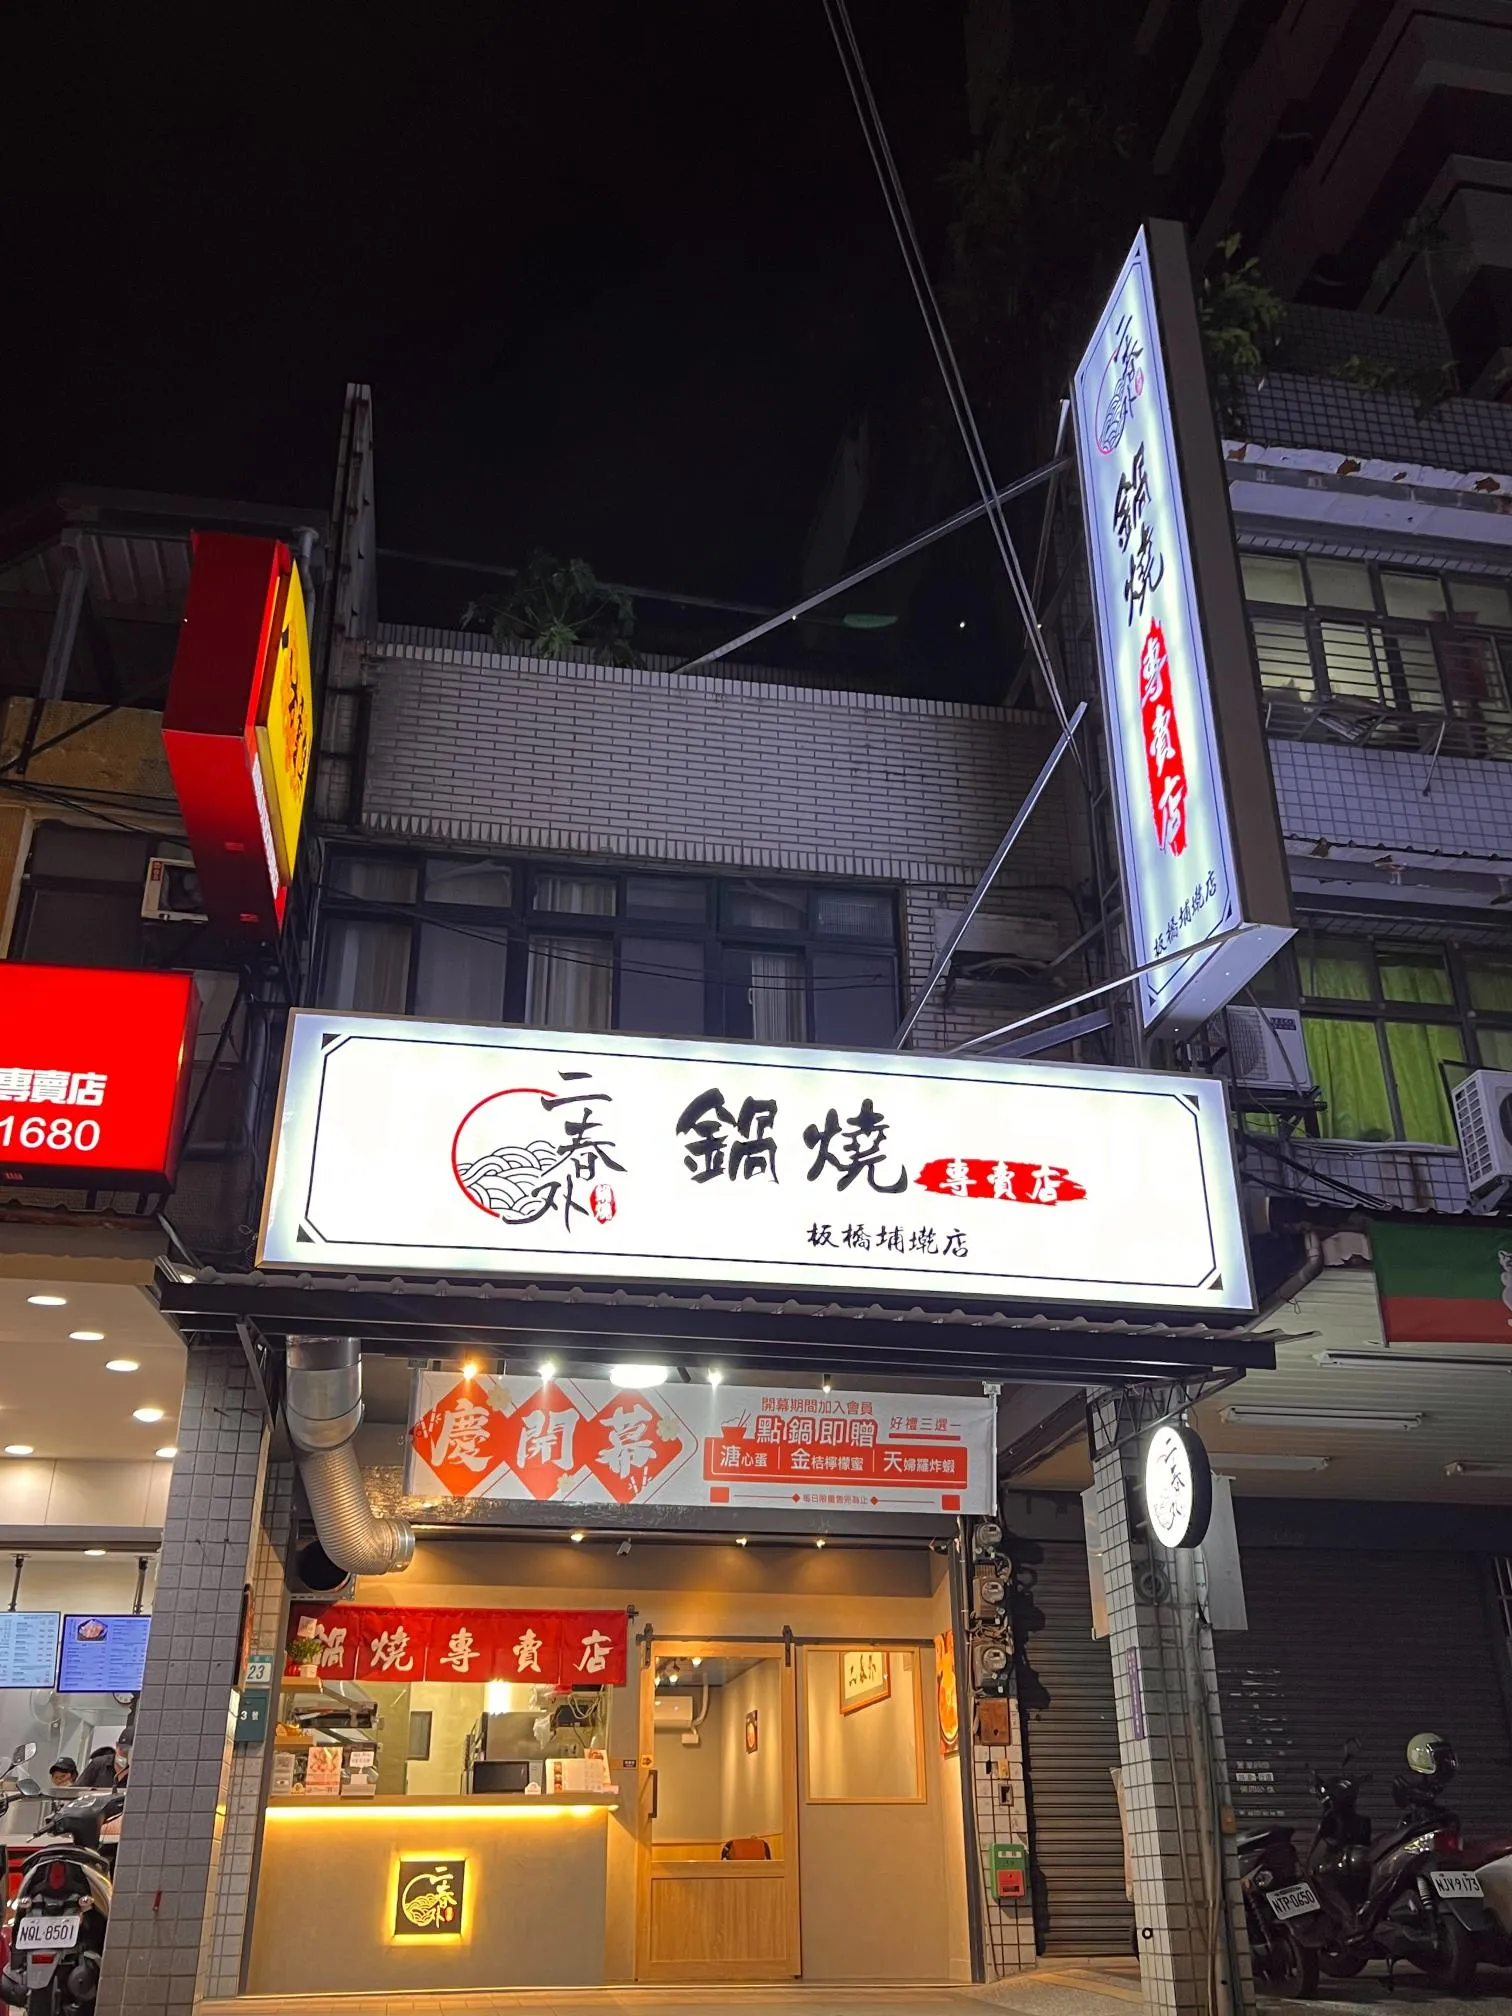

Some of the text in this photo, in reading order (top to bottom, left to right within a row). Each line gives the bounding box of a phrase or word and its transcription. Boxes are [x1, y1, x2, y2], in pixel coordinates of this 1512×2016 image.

[0, 1067, 107, 1107] 專賣店
[0, 1115, 101, 1151] 1680
[676, 1087, 1065, 1203] 鍋燒 專賣店
[761, 1396, 873, 1416] 開幕期間加入會員
[756, 1416, 874, 1448] 點鍋即贈
[889, 1416, 961, 1432] 好禮三選一
[720, 1444, 955, 1474] 溏心蛋 金桔檸檬蜜 天婦羅炸蝦
